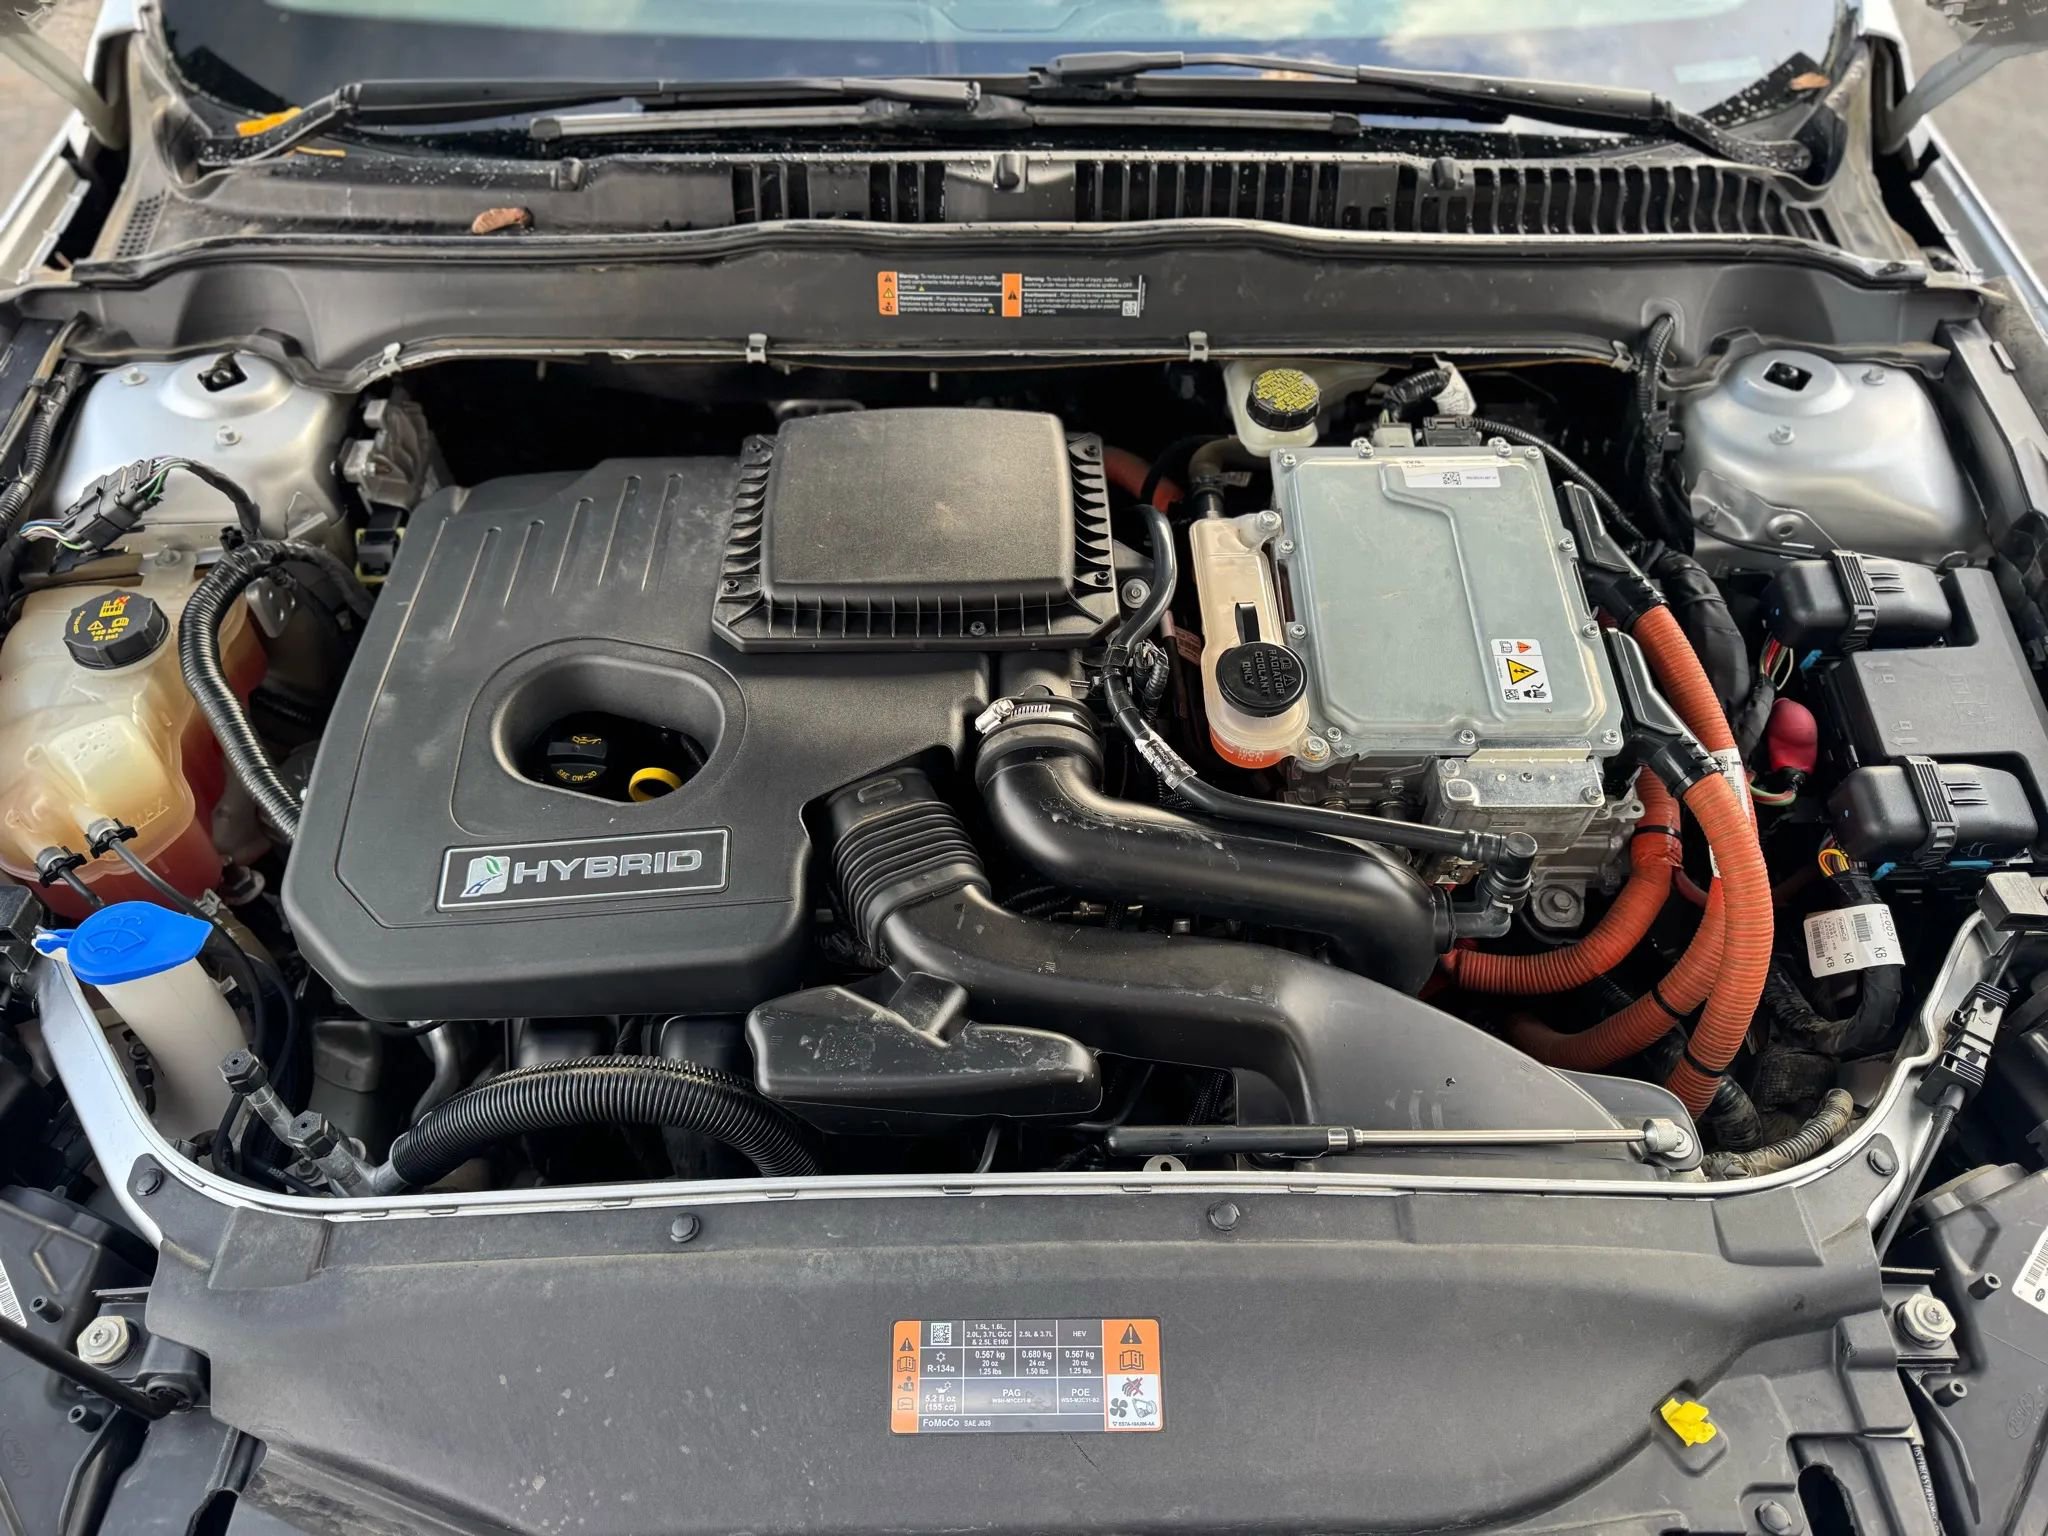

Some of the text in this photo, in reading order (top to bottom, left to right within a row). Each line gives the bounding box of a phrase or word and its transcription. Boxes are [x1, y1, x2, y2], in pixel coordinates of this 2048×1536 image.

[1242, 661, 1254, 684] ONLY
[1255, 651, 1270, 694] COOLANT
[1268, 650, 1285, 694] RADIATOR
[557, 769, 597, 781] SAE 0W-20
[513, 849, 702, 884] HYBRID
[1880, 908, 1896, 942] M-0057
[1844, 952, 1854, 964] KB
[1874, 946, 1887, 959] KB
[1825, 956, 1835, 968] KB
[975, 1350, 1005, 1360] 0.567 kg
[1043, 1350, 1052, 1360] kg
[1086, 1350, 1094, 1360] kg
[1072, 1388, 1090, 1396] POE
[925, 1403, 956, 1413] (155 cc)
[923, 1419, 960, 1427] FoMoCo
